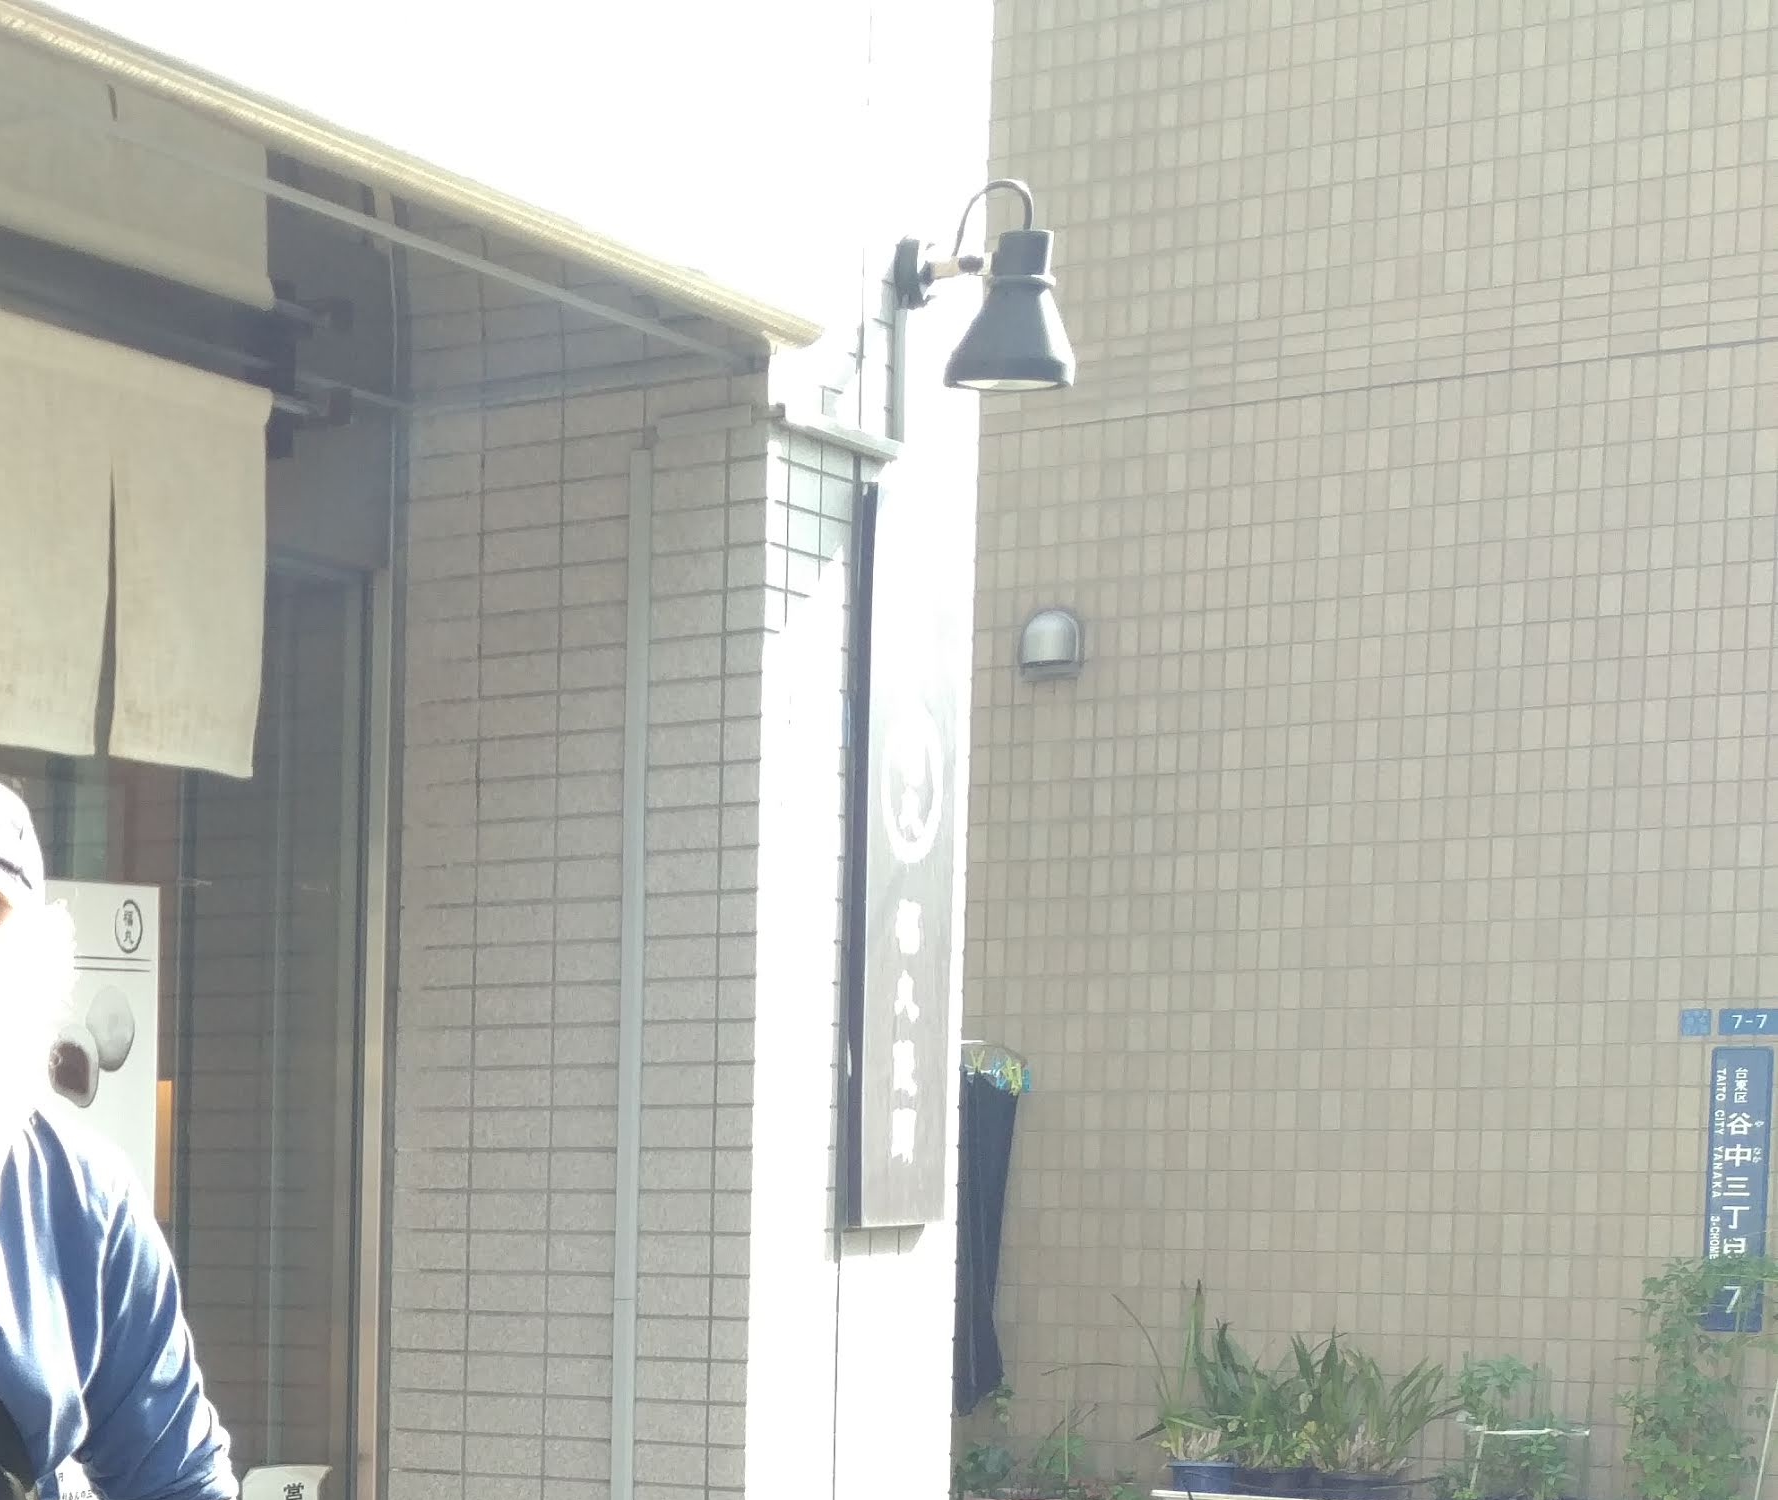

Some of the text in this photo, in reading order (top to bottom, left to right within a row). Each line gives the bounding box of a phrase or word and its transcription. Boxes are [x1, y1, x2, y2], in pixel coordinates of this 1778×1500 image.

[1731, 1014, 1768, 1029] 7-7
[1715, 1067, 1727, 1101] TAITO
[1734, 1067, 1749, 1104] 台東区
[1714, 1109, 1726, 1136] CITY
[1711, 1145, 1724, 1199] YANAKA
